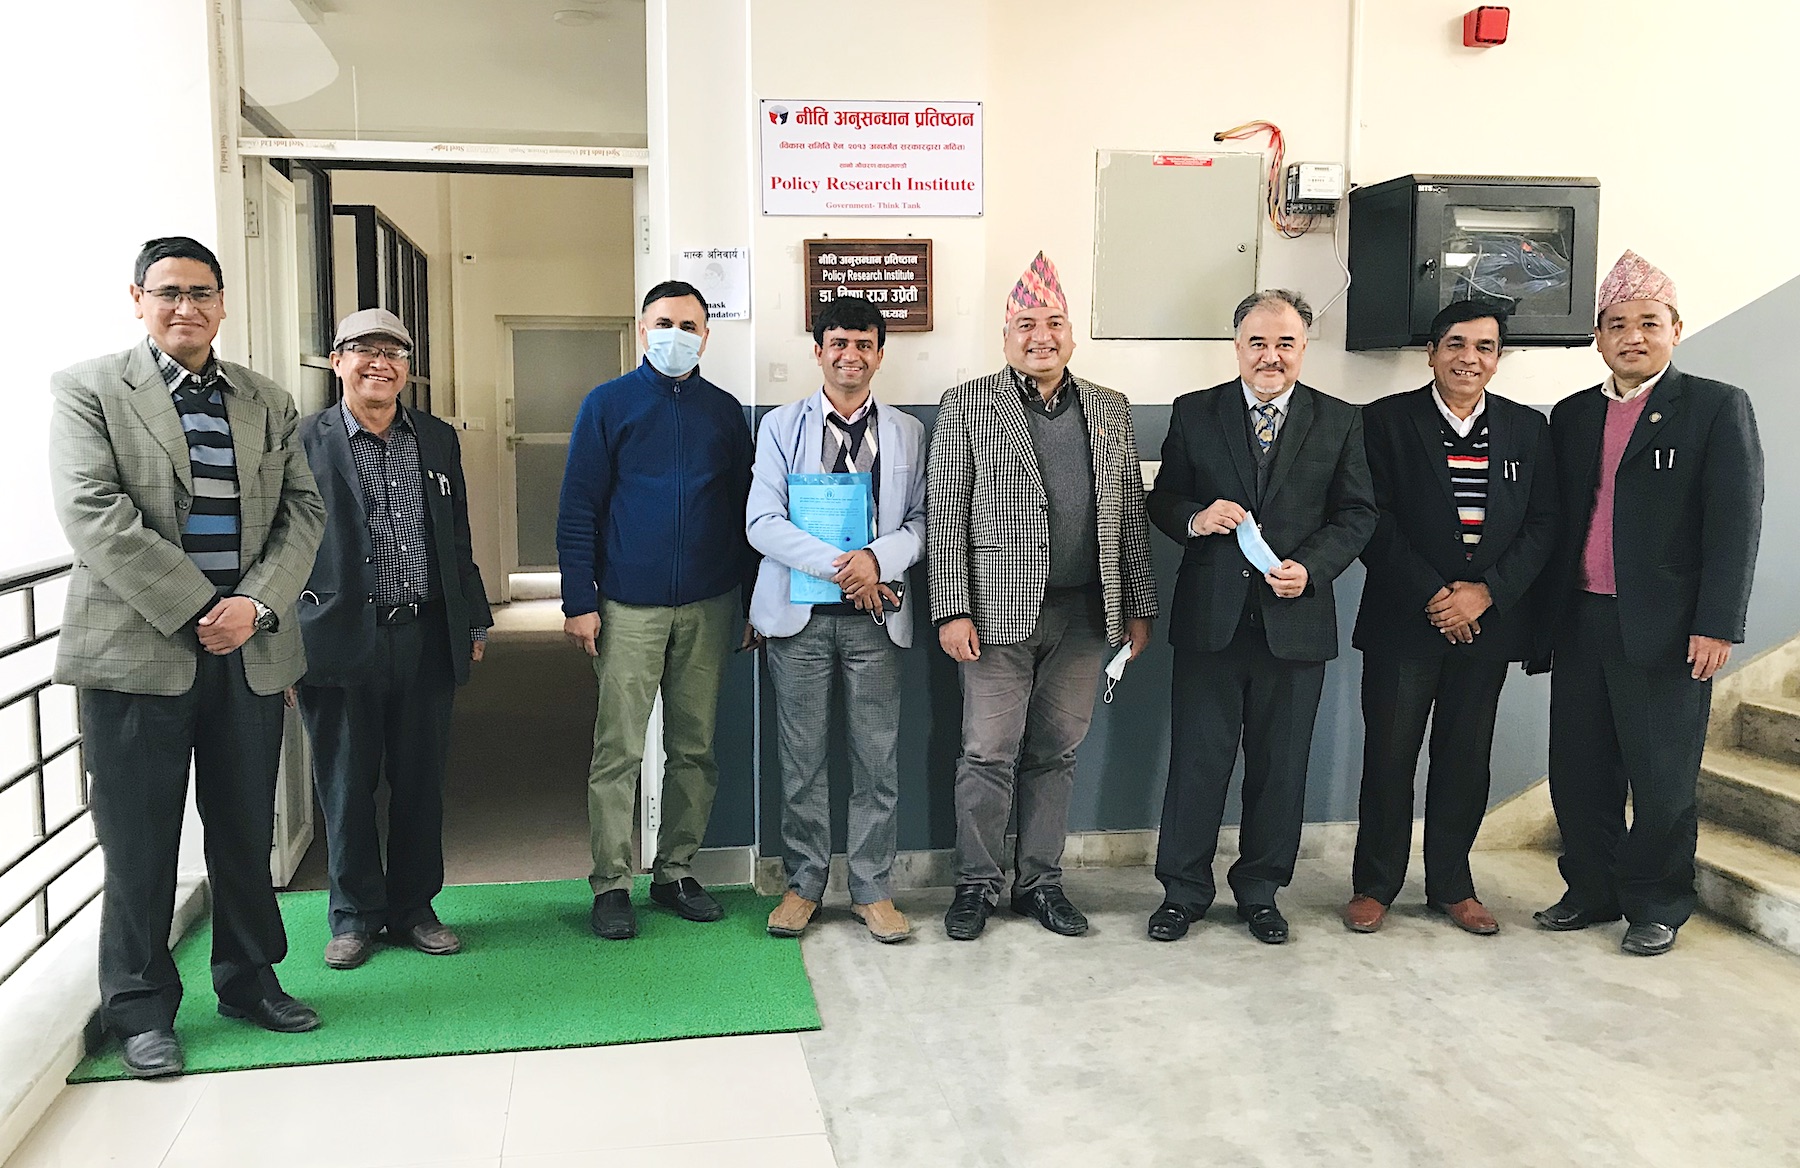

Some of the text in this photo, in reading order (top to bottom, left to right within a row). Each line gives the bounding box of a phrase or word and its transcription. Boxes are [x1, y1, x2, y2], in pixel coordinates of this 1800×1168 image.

[795, 106, 975, 130] नीति अनुसन्धान प्रतिष्ठान
[807, 141, 831, 150] समिति
[832, 142, 844, 150] ऐन
[770, 176, 975, 193] Policy Research Institute
[825, 201, 875, 209] Government-
[683, 250, 704, 259] मास्क
[707, 247, 739, 259] अनिवार्य
[818, 253, 919, 267] नीति अनुसन्धान प्रतिष्ठान
[822, 269, 915, 283] Policy Research Institute
[819, 289, 835, 302] डा.
[866, 289, 888, 303] राज
[890, 285, 918, 304] उप्रेती
